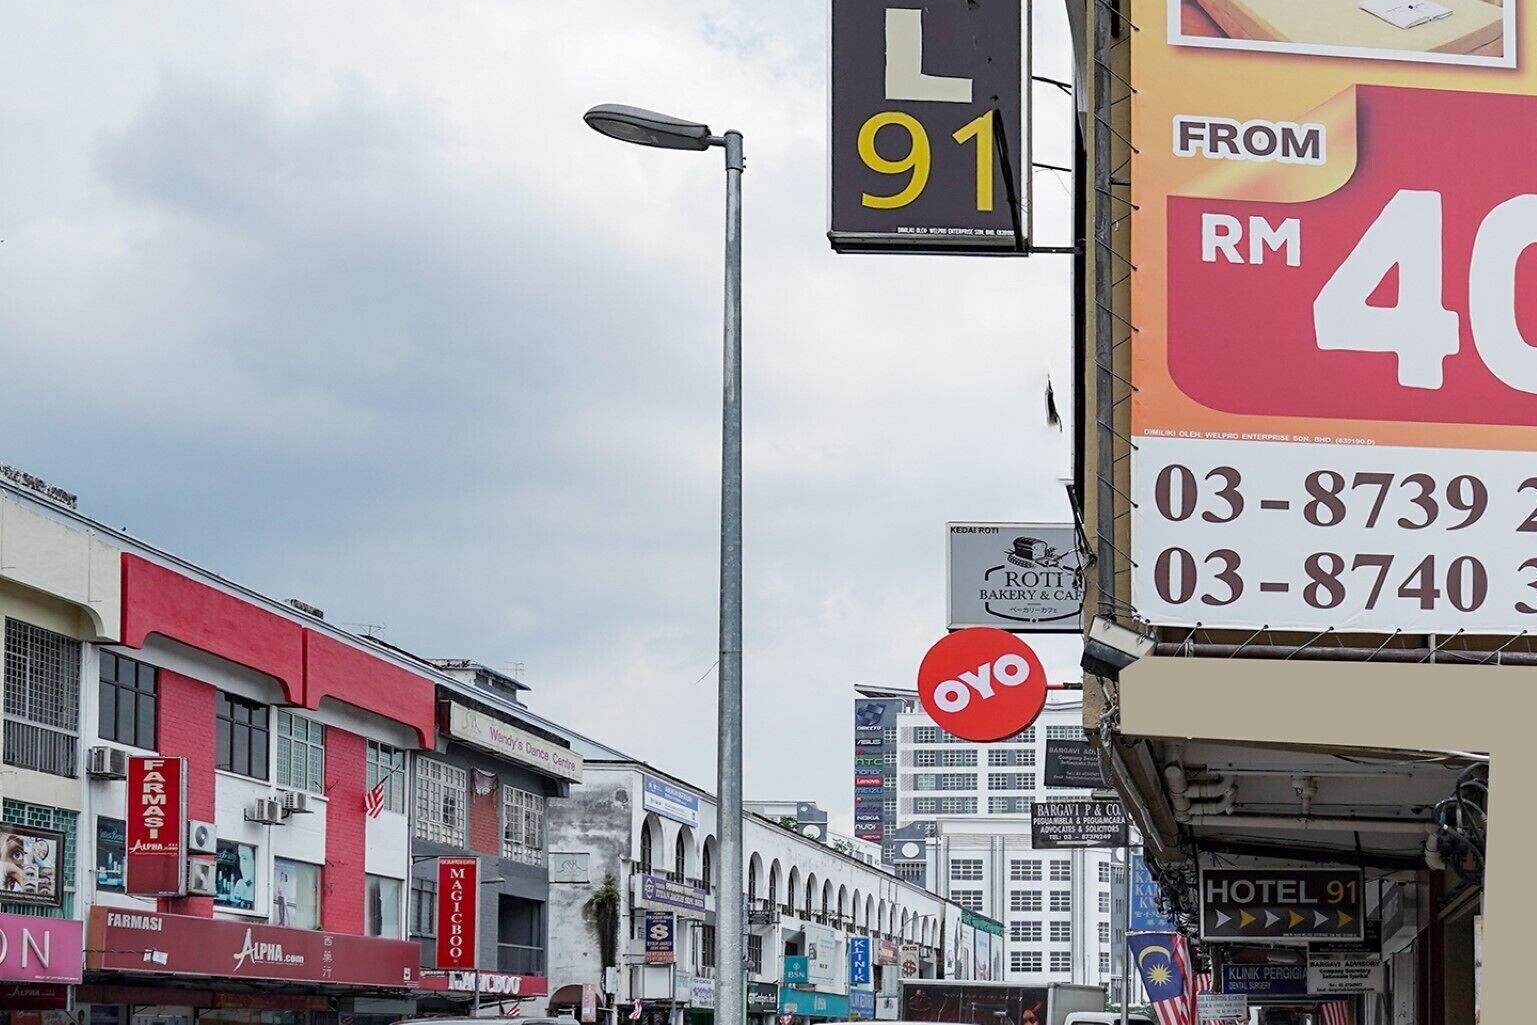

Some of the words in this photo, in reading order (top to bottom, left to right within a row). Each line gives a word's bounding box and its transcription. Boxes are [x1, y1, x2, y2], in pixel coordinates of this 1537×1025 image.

[1175, 116, 1325, 164] FROM
[856, 110, 994, 212] 91
[1201, 212, 1301, 267] RM
[1144, 428, 1176, 437] DIMILIKI
[1205, 431, 1239, 440] WELPRO
[1241, 433, 1290, 442] ENTERPRISE
[1004, 571, 1063, 588] ROTI
[980, 589, 1037, 601] BAKERY
[1039, 590, 1050, 601] &
[933, 652, 1030, 714] OYO
[489, 726, 523, 751] Wendy's
[525, 742, 549, 761] Dance
[552, 753, 576, 772] Centre
[142, 759, 167, 839] FARMASI
[1037, 803, 1079, 816] BARGAVI
[1084, 804, 1092, 816] P
[1094, 804, 1102, 815] &
[1040, 826, 1076, 834] ADVOCATES
[1085, 825, 1120, 833] SOLICITORS
[1083, 816, 1126, 824] PEGUAMCARA
[1206, 879, 1318, 904] HOTEL
[1326, 880, 1358, 904] 91
[107, 912, 162, 932] FARMASI
[450, 868, 465, 958] MAGICBOO
[854, 940, 866, 982] KLINIK
[1228, 967, 1260, 980] KLINIK
